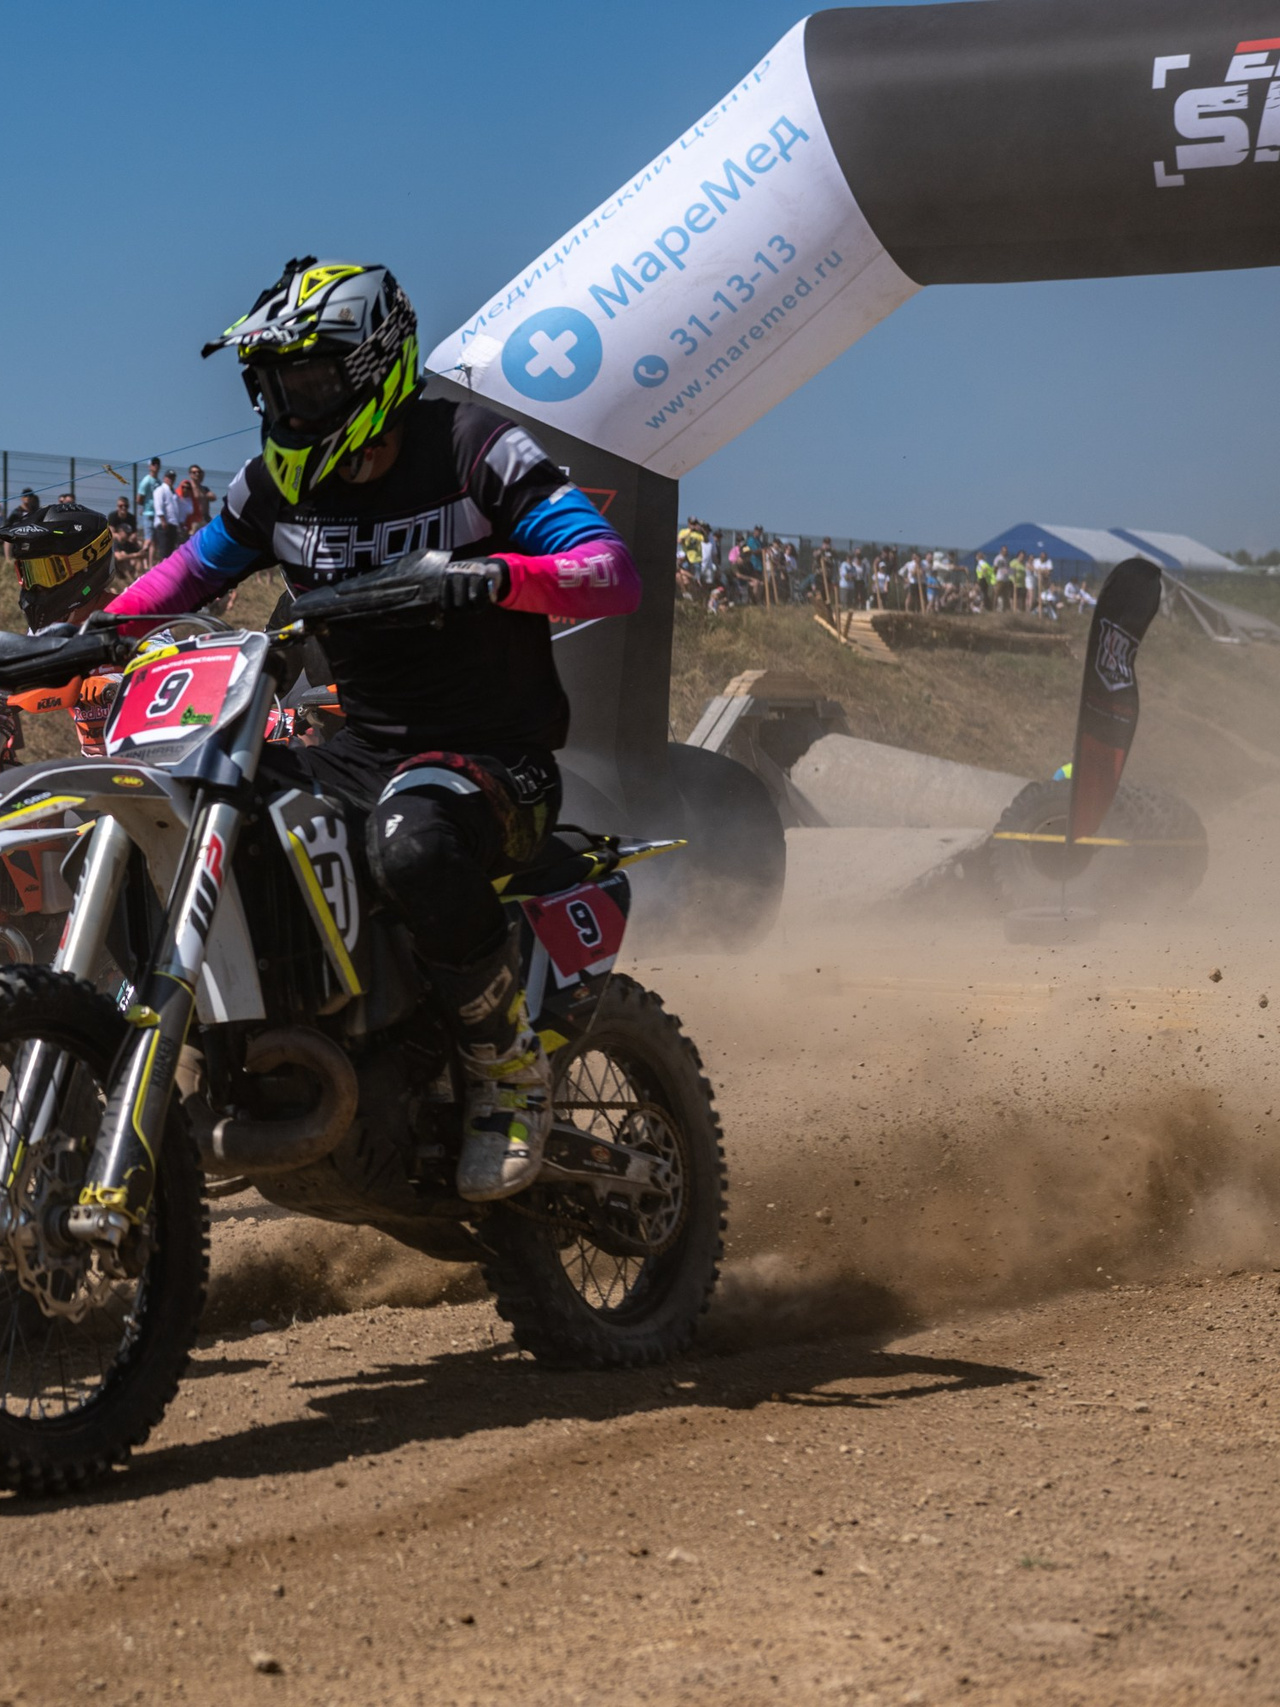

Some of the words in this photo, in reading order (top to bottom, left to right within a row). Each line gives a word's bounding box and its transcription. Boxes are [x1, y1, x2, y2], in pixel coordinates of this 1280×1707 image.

[1224, 37, 1280, 82] E
[587, 115, 810, 320] МареМед
[669, 234, 796, 356] 31-13-13
[644, 249, 844, 430] www.maremed.ru
[37, 695, 62, 710] KTM
[75, 704, 94, 720] Red
[146, 668, 194, 718] 9
[566, 900, 602, 947] 9
